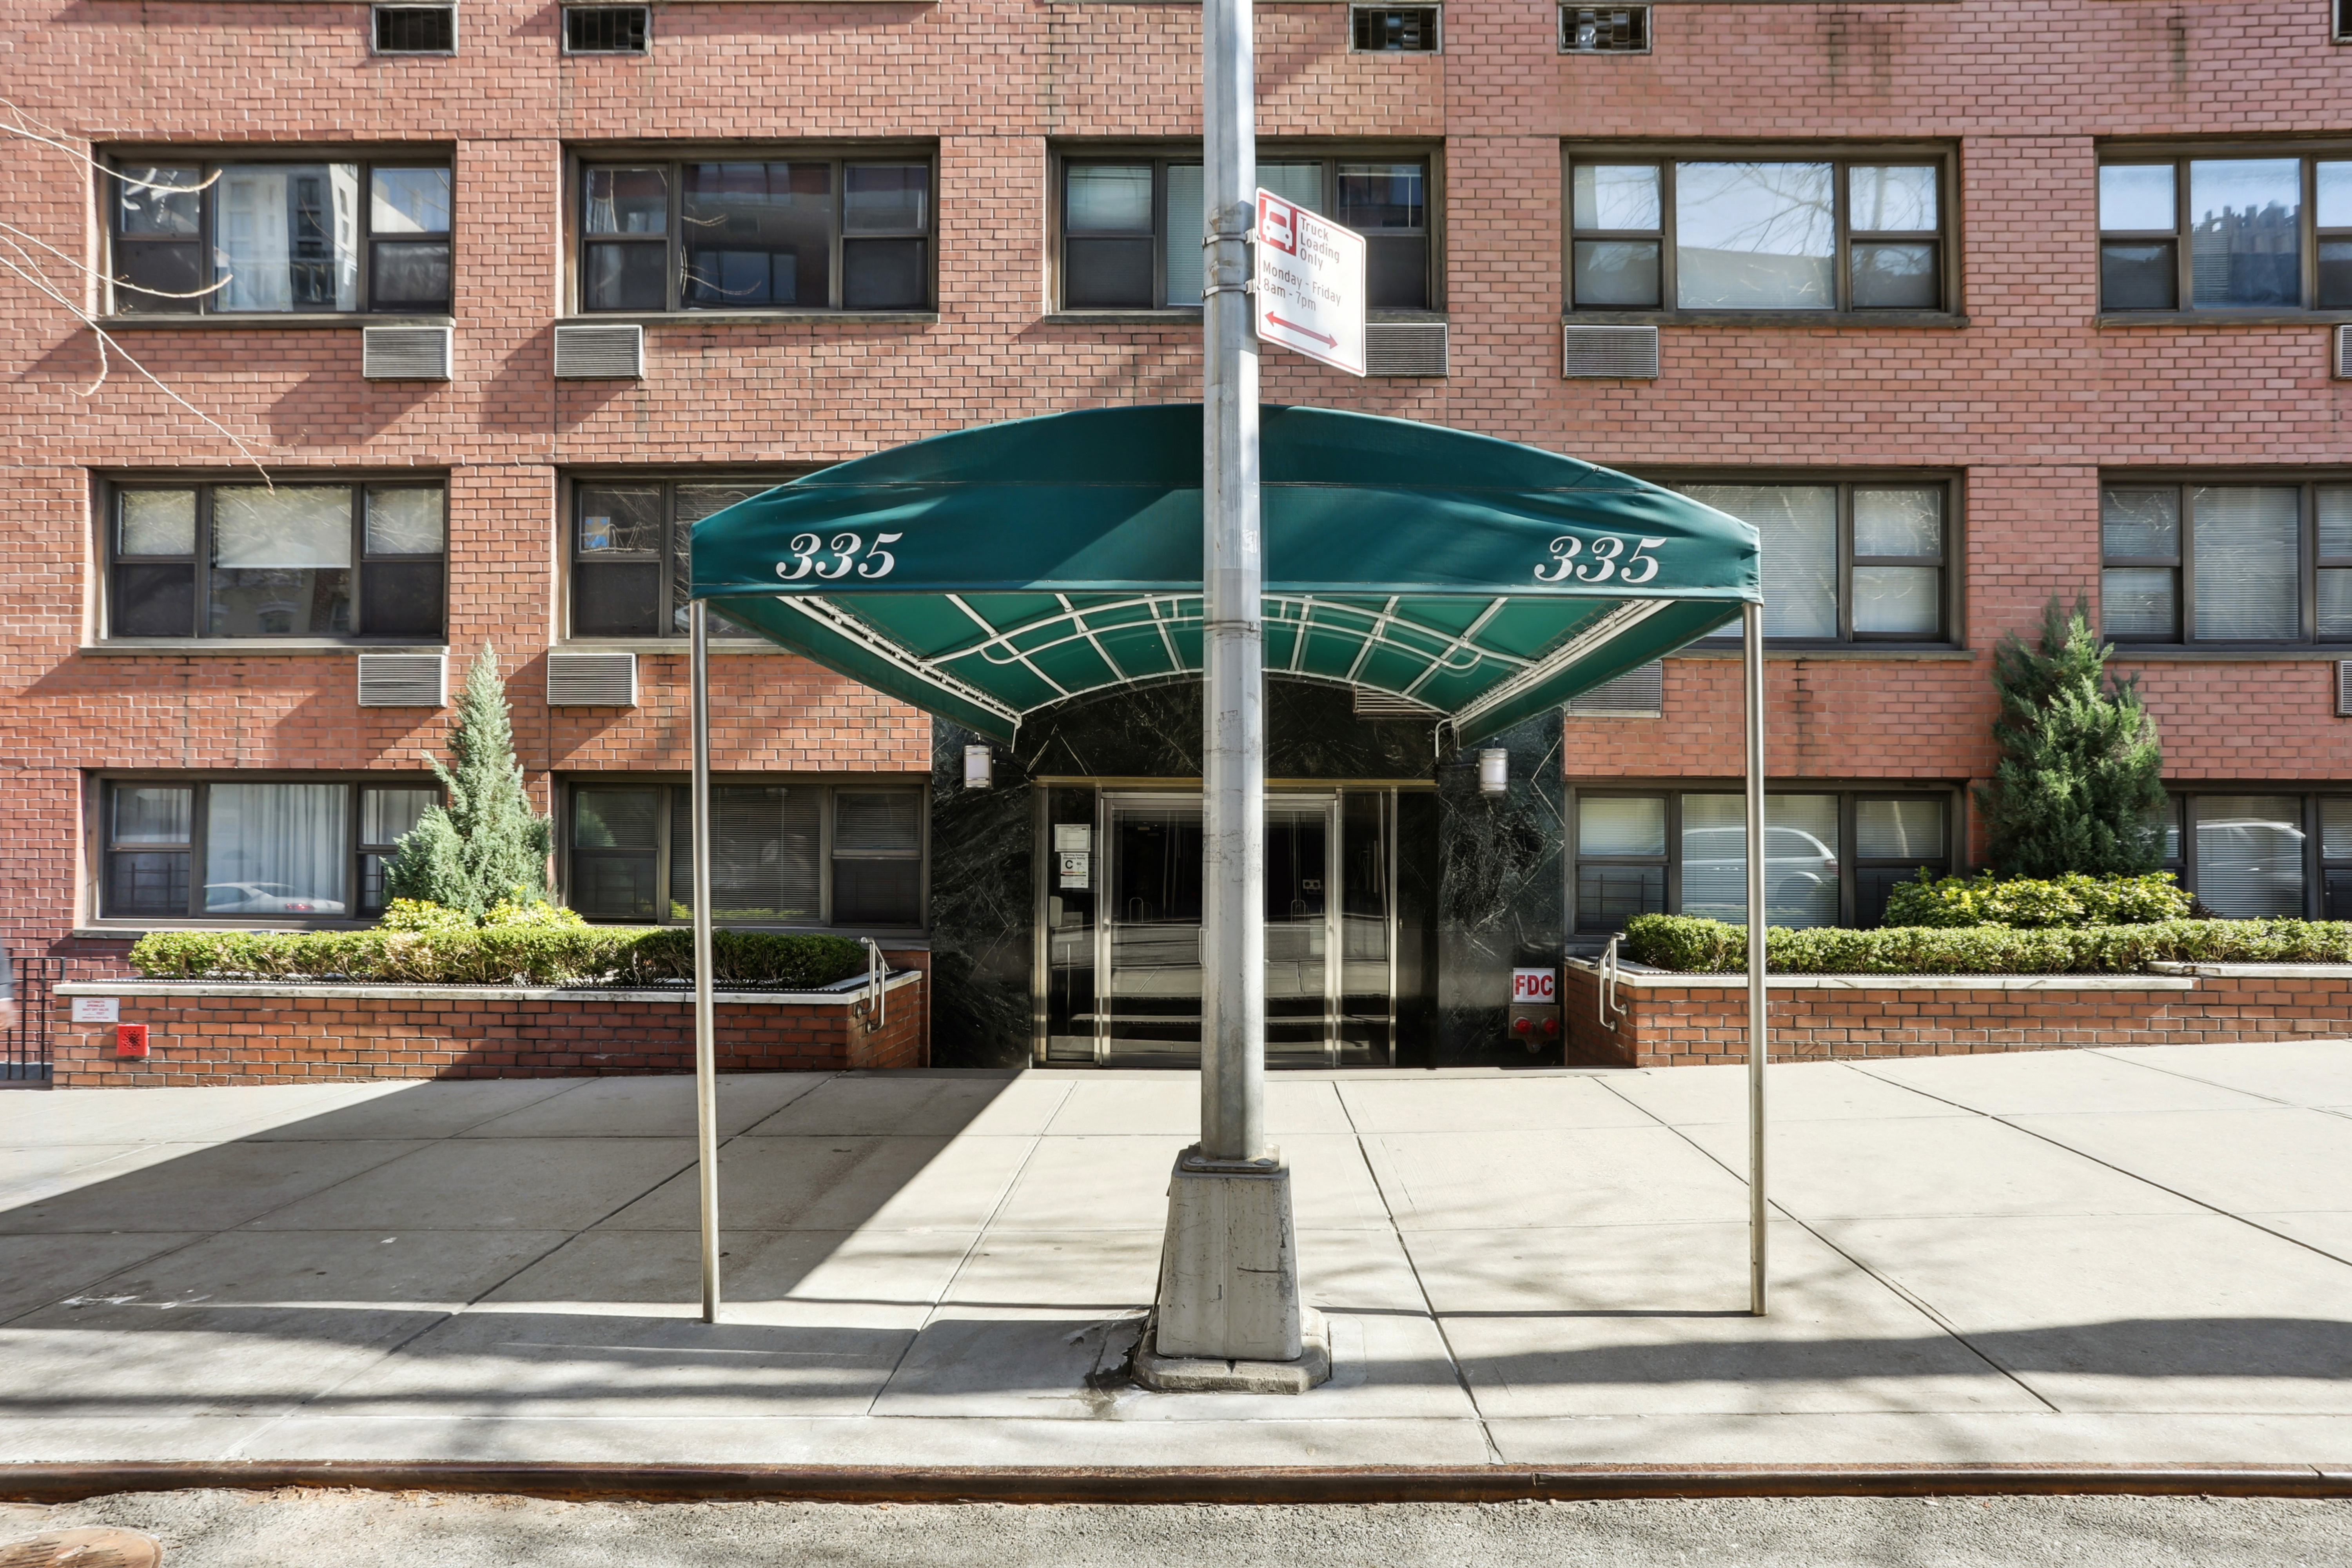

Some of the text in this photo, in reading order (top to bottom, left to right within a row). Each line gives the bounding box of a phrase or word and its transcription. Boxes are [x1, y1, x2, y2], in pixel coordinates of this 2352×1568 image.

[1301, 217, 1328, 241] Truck
[1300, 249, 1323, 271] Only
[1301, 233, 1340, 263] Loading
[1263, 260, 1302, 290] Monday
[1312, 281, 1341, 307] Friday
[1263, 278, 1286, 299] 8am
[1296, 291, 1316, 311] 7pm
[776, 532, 903, 579] 335
[1534, 535, 1667, 583] 335
[1065, 860, 1073, 869] C
[1515, 975, 1553, 996] FDC
